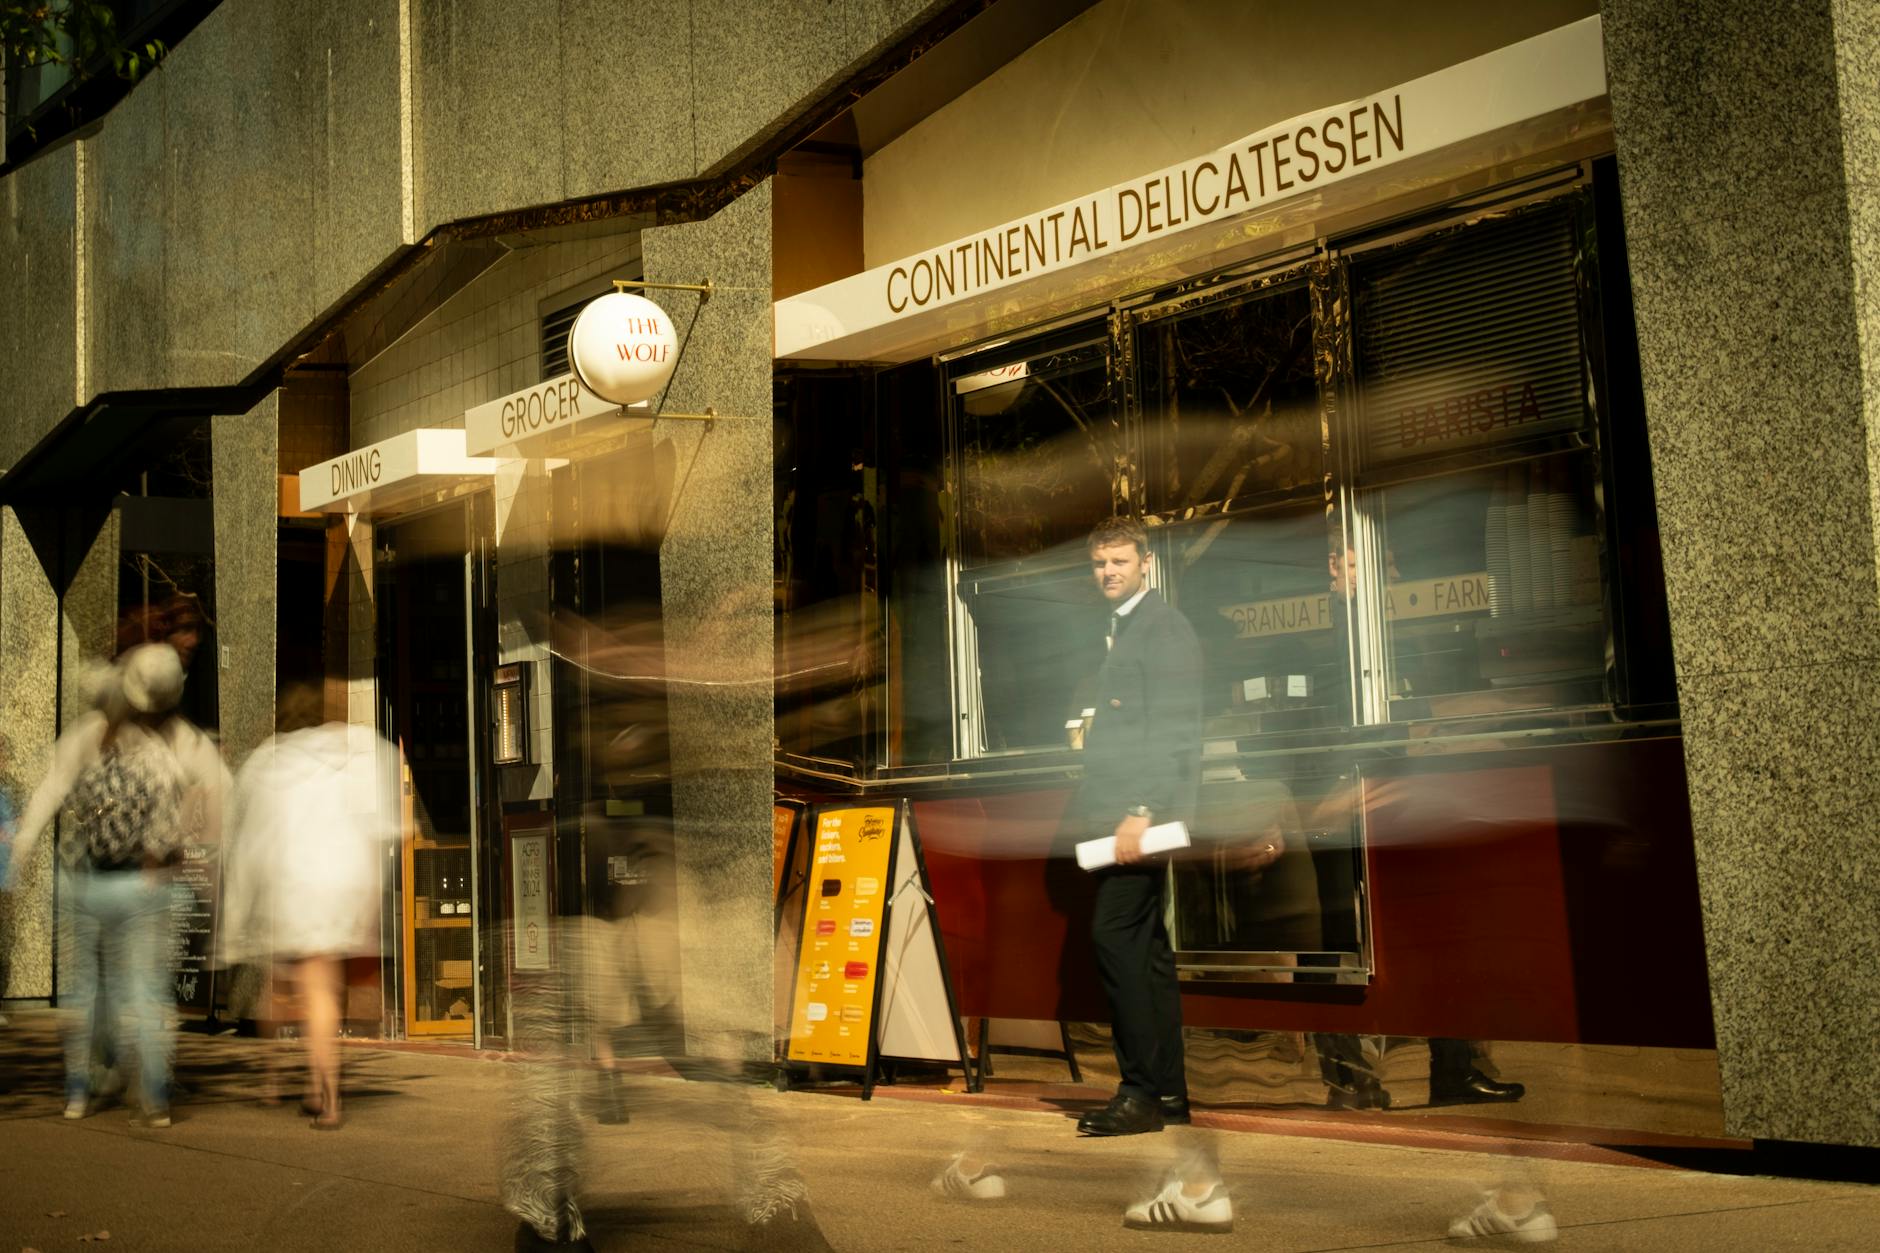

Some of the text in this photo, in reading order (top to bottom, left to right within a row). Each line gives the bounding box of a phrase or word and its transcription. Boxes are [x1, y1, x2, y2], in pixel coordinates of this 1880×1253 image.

[887, 94, 1405, 314] CONTINENTAL DELICATESSEN
[627, 317, 664, 336] THE
[616, 343, 671, 363] WOLF
[501, 377, 581, 438] GROCER
[1400, 382, 1542, 448] BARISTA
[331, 448, 382, 497] DINING
[1232, 599, 1311, 635] GRANJA
